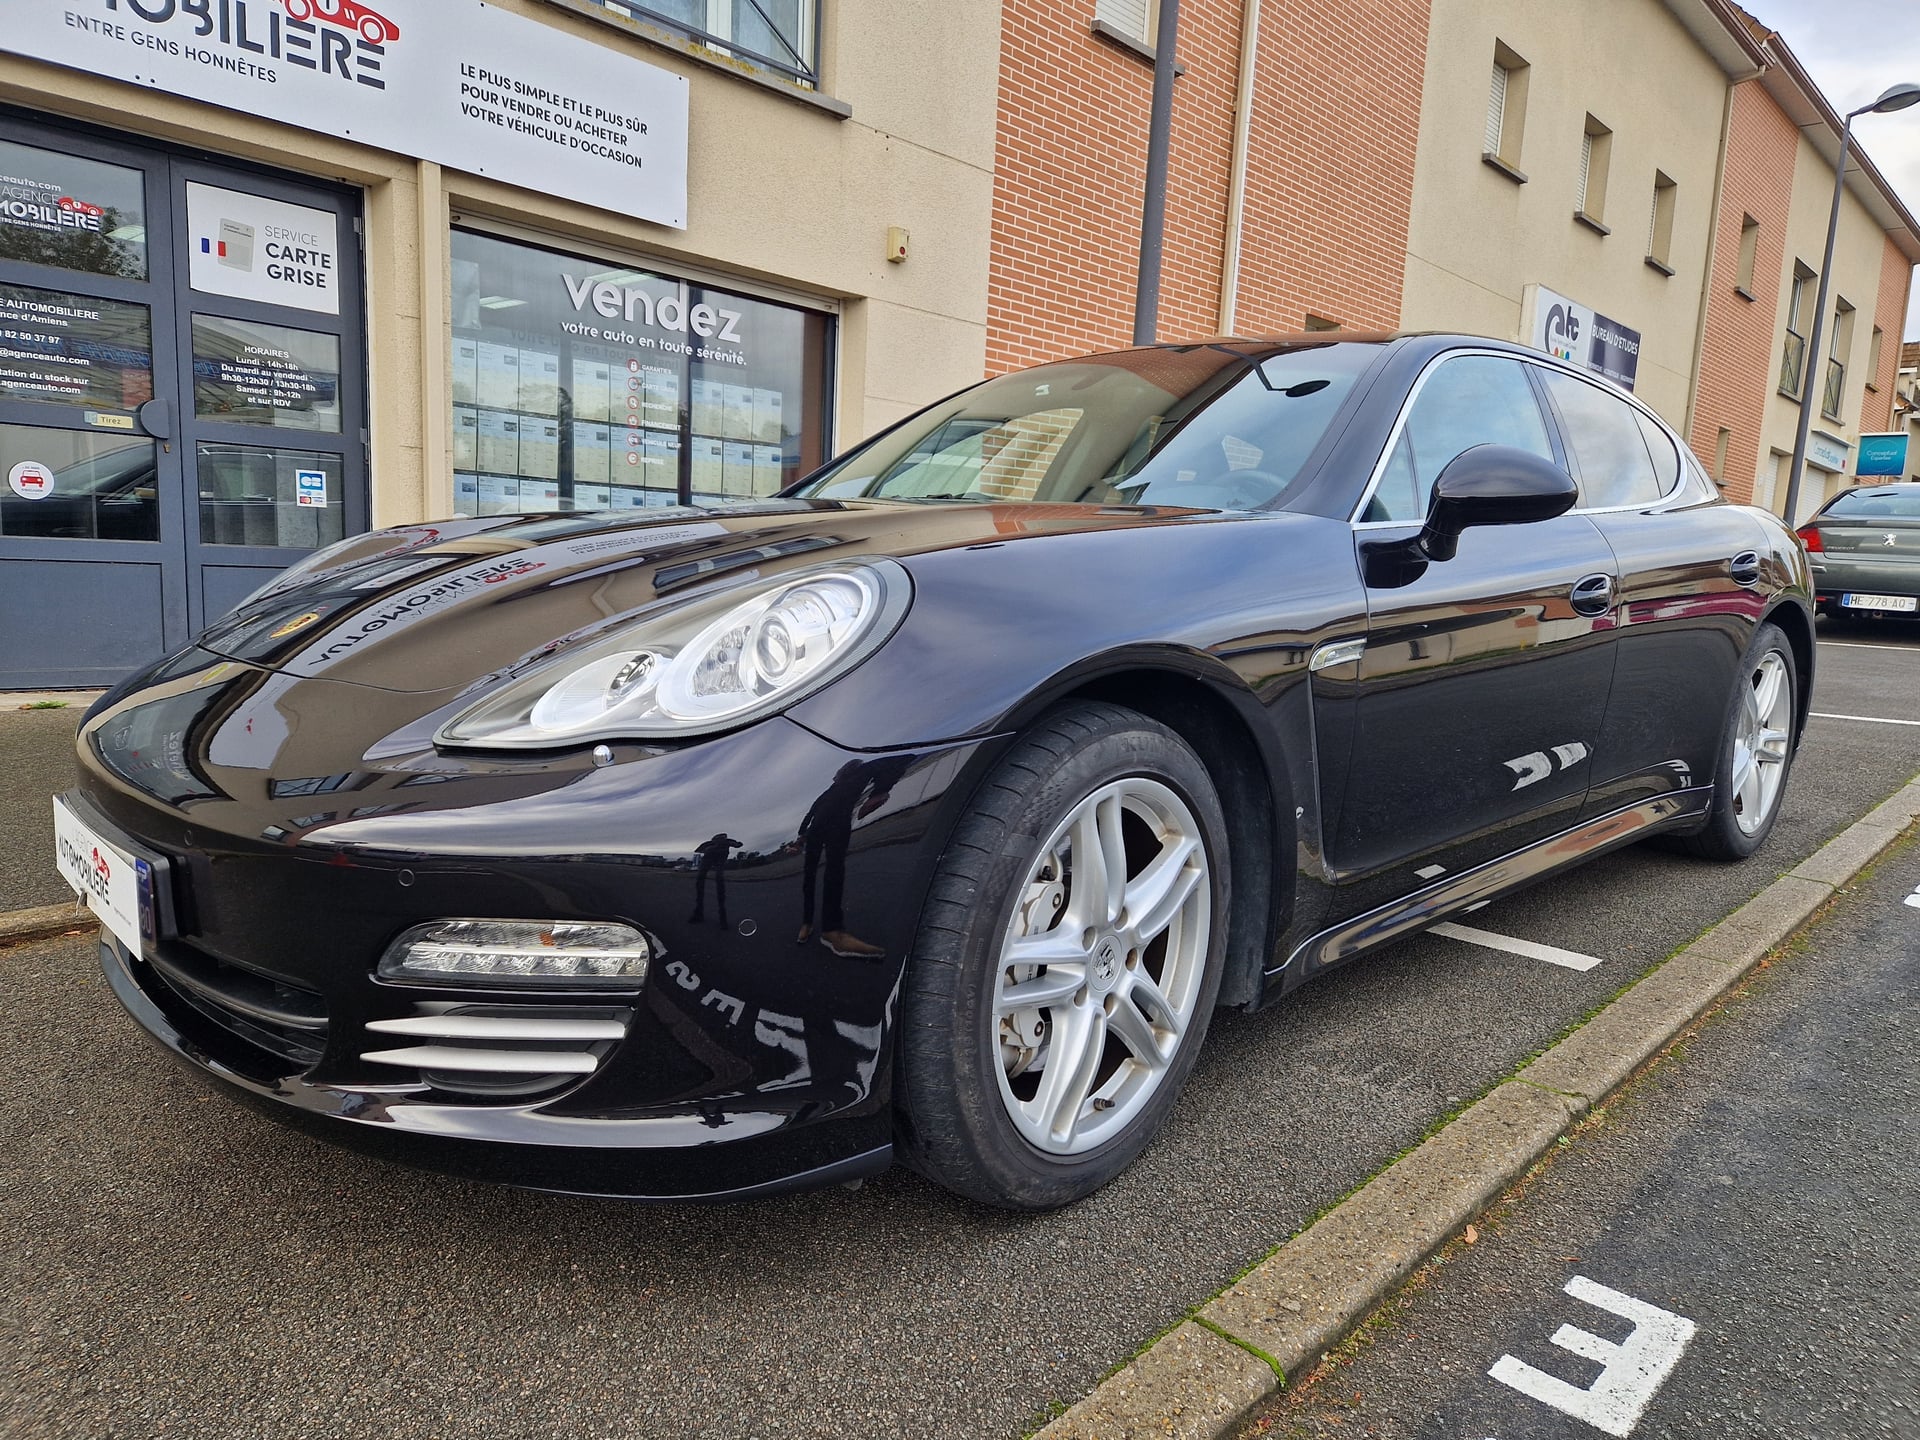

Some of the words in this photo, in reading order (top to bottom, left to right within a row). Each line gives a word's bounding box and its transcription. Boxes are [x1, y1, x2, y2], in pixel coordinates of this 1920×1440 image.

[64, 11, 125, 41] ENTRE
[131, 31, 179, 56] GENS
[184, 46, 277, 83] HONNÊTES
[104, 0, 385, 90] BILIERE
[460, 62, 476, 79] LE
[479, 69, 511, 90] PLUS
[514, 81, 560, 107] SIMPLE
[563, 97, 577, 112] ET
[579, 103, 593, 117] LE
[595, 108, 624, 127] PLUS
[626, 117, 648, 135] SÛR
[461, 82, 499, 106] POUR
[501, 95, 551, 122] VENDRE
[554, 113, 572, 129] OU
[574, 120, 628, 147] ACHETER
[461, 101, 504, 127] VOTRE
[506, 115, 567, 146] VÉHICULE
[570, 136, 642, 169] D'OCCASION
[264, 225, 318, 247] SERVICE
[265, 242, 331, 269] CARTE
[266, 264, 327, 288] GRISE
[6, 299, 100, 320] AUTOMOBILIERE
[562, 272, 742, 344] vendez
[21, 313, 68, 327] d'Amiens
[4, 330, 17, 339] 82
[19, 332, 32, 341] 50
[34, 334, 46, 342] 37
[48, 336, 60, 345] 97
[561, 321, 599, 338] votre
[602, 329, 635, 345] auto
[638, 337, 655, 349] en
[658, 337, 693, 356] toute
[696, 344, 747, 366] sérénité.
[1592, 324, 1614, 345] BUREAU
[235, 355, 260, 366] Lundi
[267, 360, 299, 371] 14h-18h
[244, 346, 289, 359] HORAIRES
[29, 372, 42, 380] du
[44, 374, 71, 383] stock
[221, 364, 234, 372] Du
[235, 367, 259, 376] mardi
[273, 371, 308, 382] vendredi
[221, 373, 269, 387] 9h30-12h30
[275, 379, 317, 392] 13h30-18h
[235, 385, 268, 396] Samedi
[273, 389, 302, 399] 9h-12h
[272, 399, 292, 408] RDV
[101, 415, 122, 425] Tirez
[1868, 597, 1888, 606] 778
